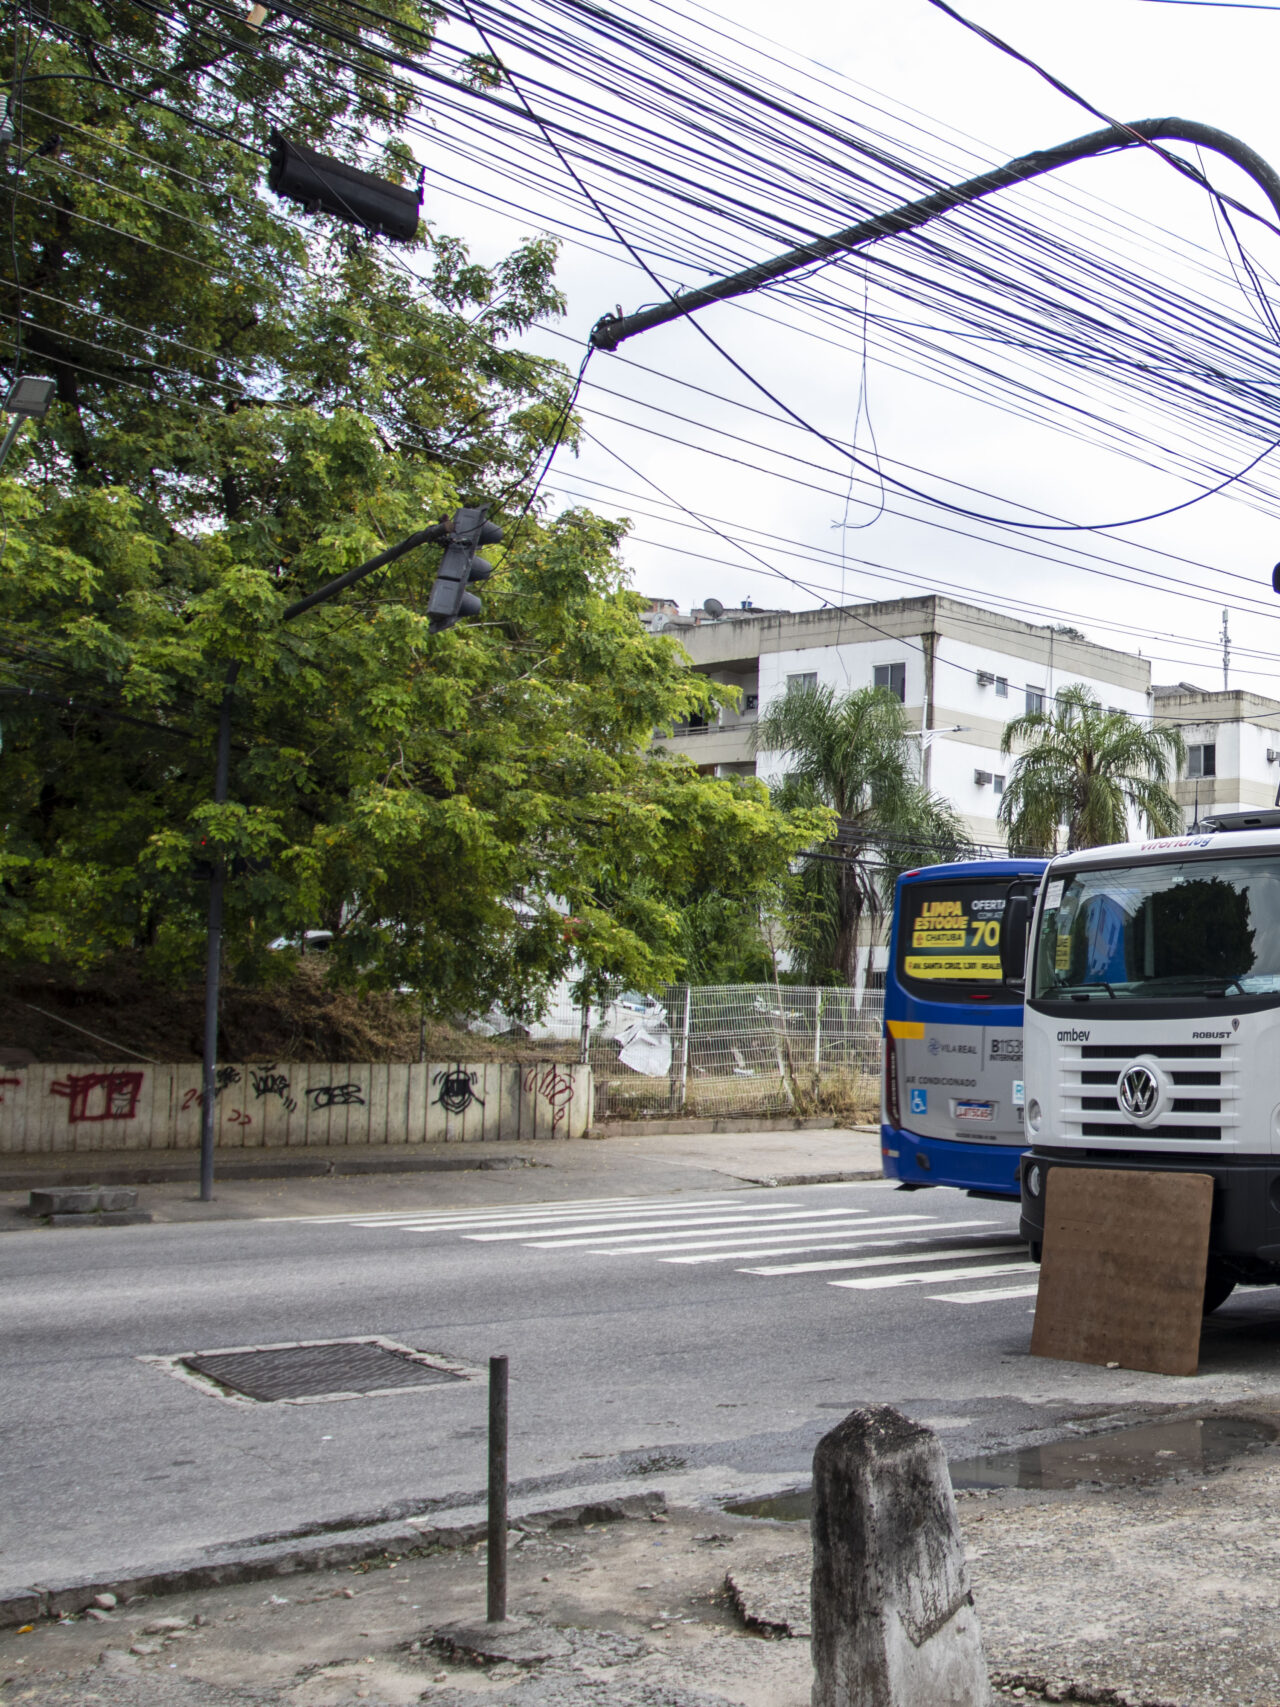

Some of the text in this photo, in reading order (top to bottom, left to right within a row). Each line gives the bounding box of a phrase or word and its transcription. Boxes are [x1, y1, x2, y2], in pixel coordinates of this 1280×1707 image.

[921, 901, 963, 917] LIMPA
[914, 916, 969, 931] ESTOQUE
[925, 932, 963, 943] CHATUBA
[971, 920, 1000, 947] 70
[1056, 1028, 1232, 1042] ambev ROBUST
[941, 1044, 978, 1055] VILA REAL
[919, 1077, 978, 1088] CONDICIONADO
